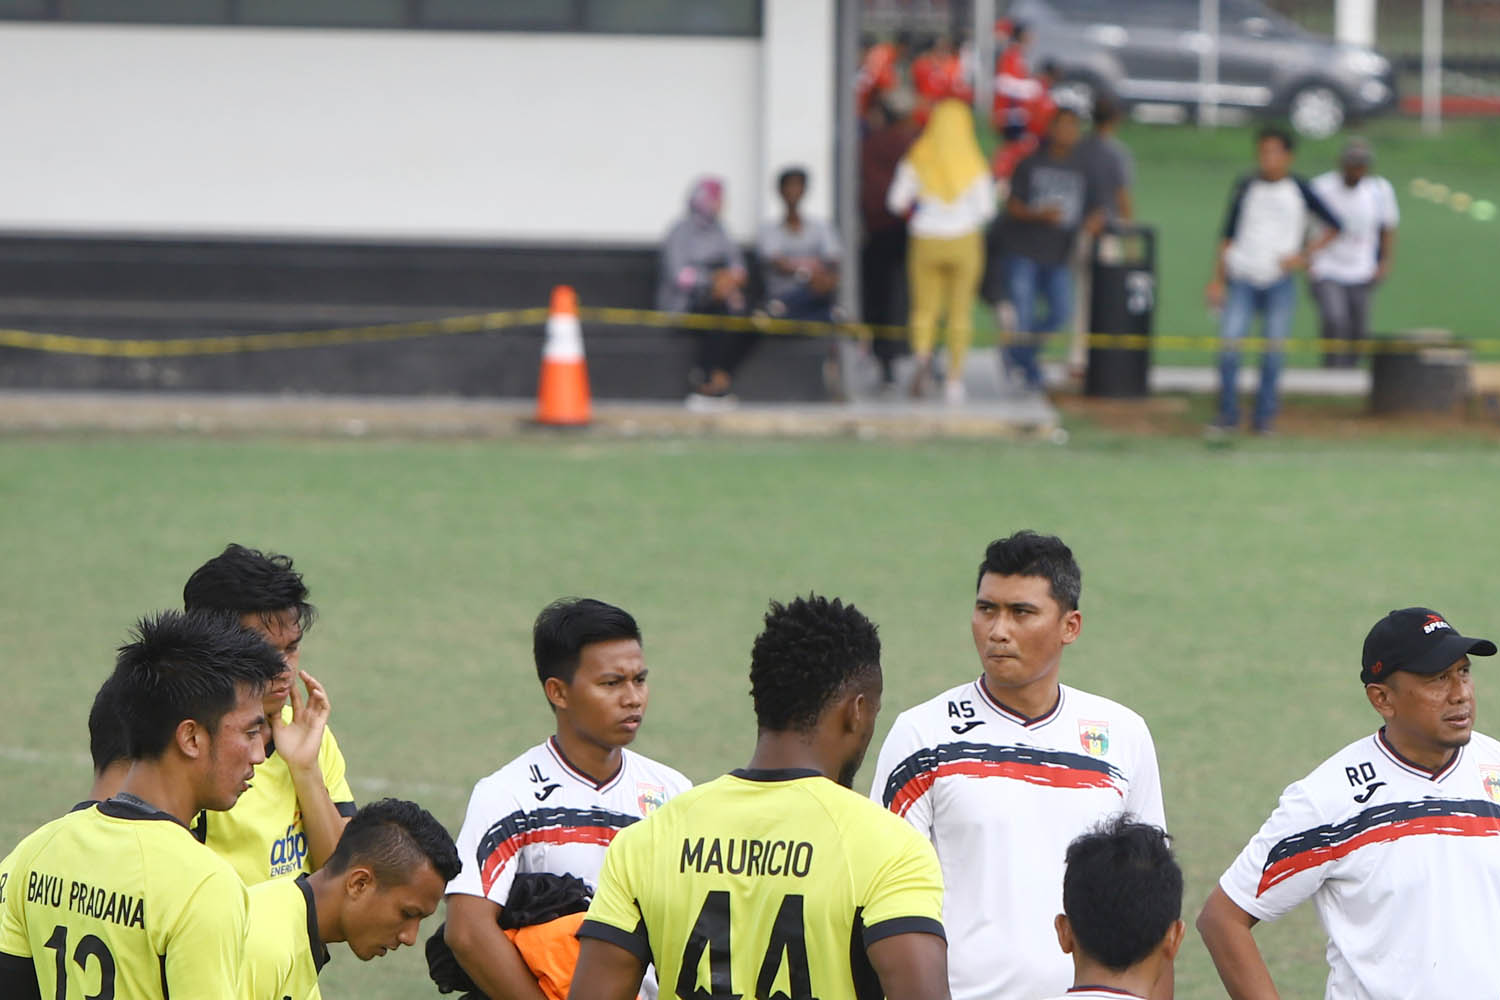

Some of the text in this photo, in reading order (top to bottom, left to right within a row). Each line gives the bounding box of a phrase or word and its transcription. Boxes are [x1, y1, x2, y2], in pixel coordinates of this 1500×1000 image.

[948, 701, 975, 718] AS
[529, 764, 550, 783] JL
[1345, 762, 1377, 787] RD
[680, 837, 814, 878] MAURICIO
[27, 871, 146, 930] BAYU PRADANA
